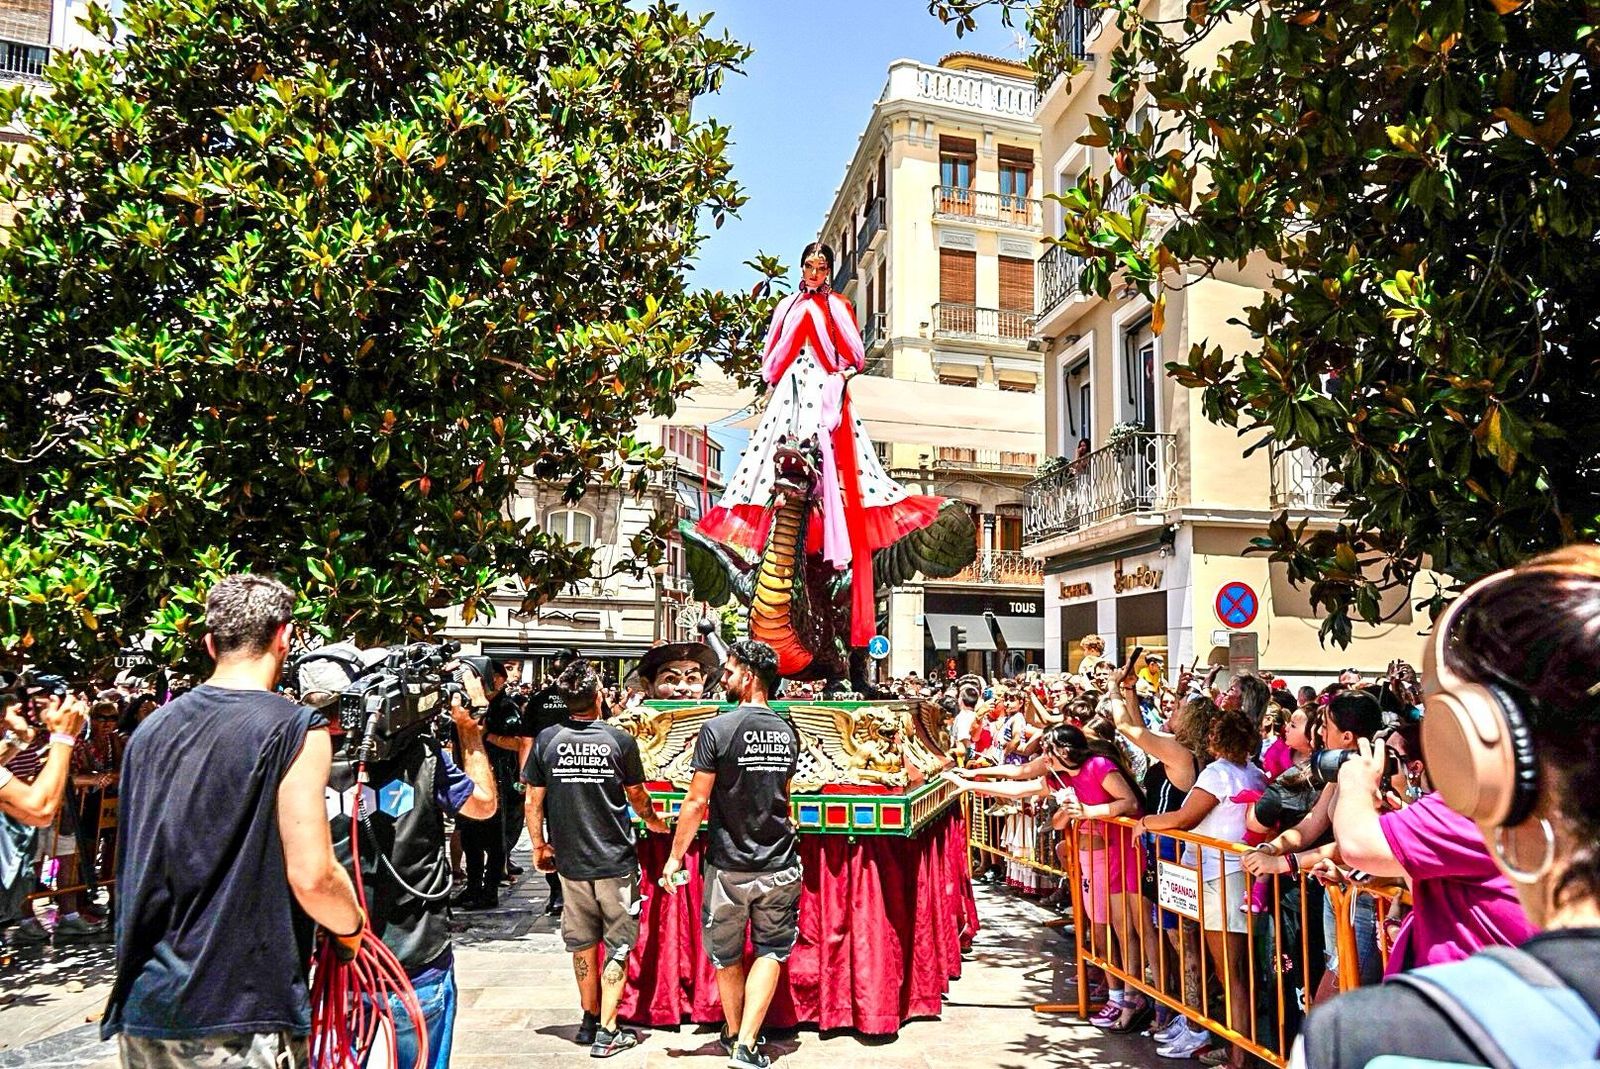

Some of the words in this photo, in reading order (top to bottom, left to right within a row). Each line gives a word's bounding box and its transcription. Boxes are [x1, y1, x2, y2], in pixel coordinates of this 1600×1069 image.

[1009, 602, 1037, 613] TOUS
[743, 730, 790, 744] CALERO
[556, 742, 611, 756] CALERO
[744, 743, 791, 755] AGUILERA
[557, 756, 609, 767] AGUILERA
[1171, 882, 1197, 899] GRANADA
